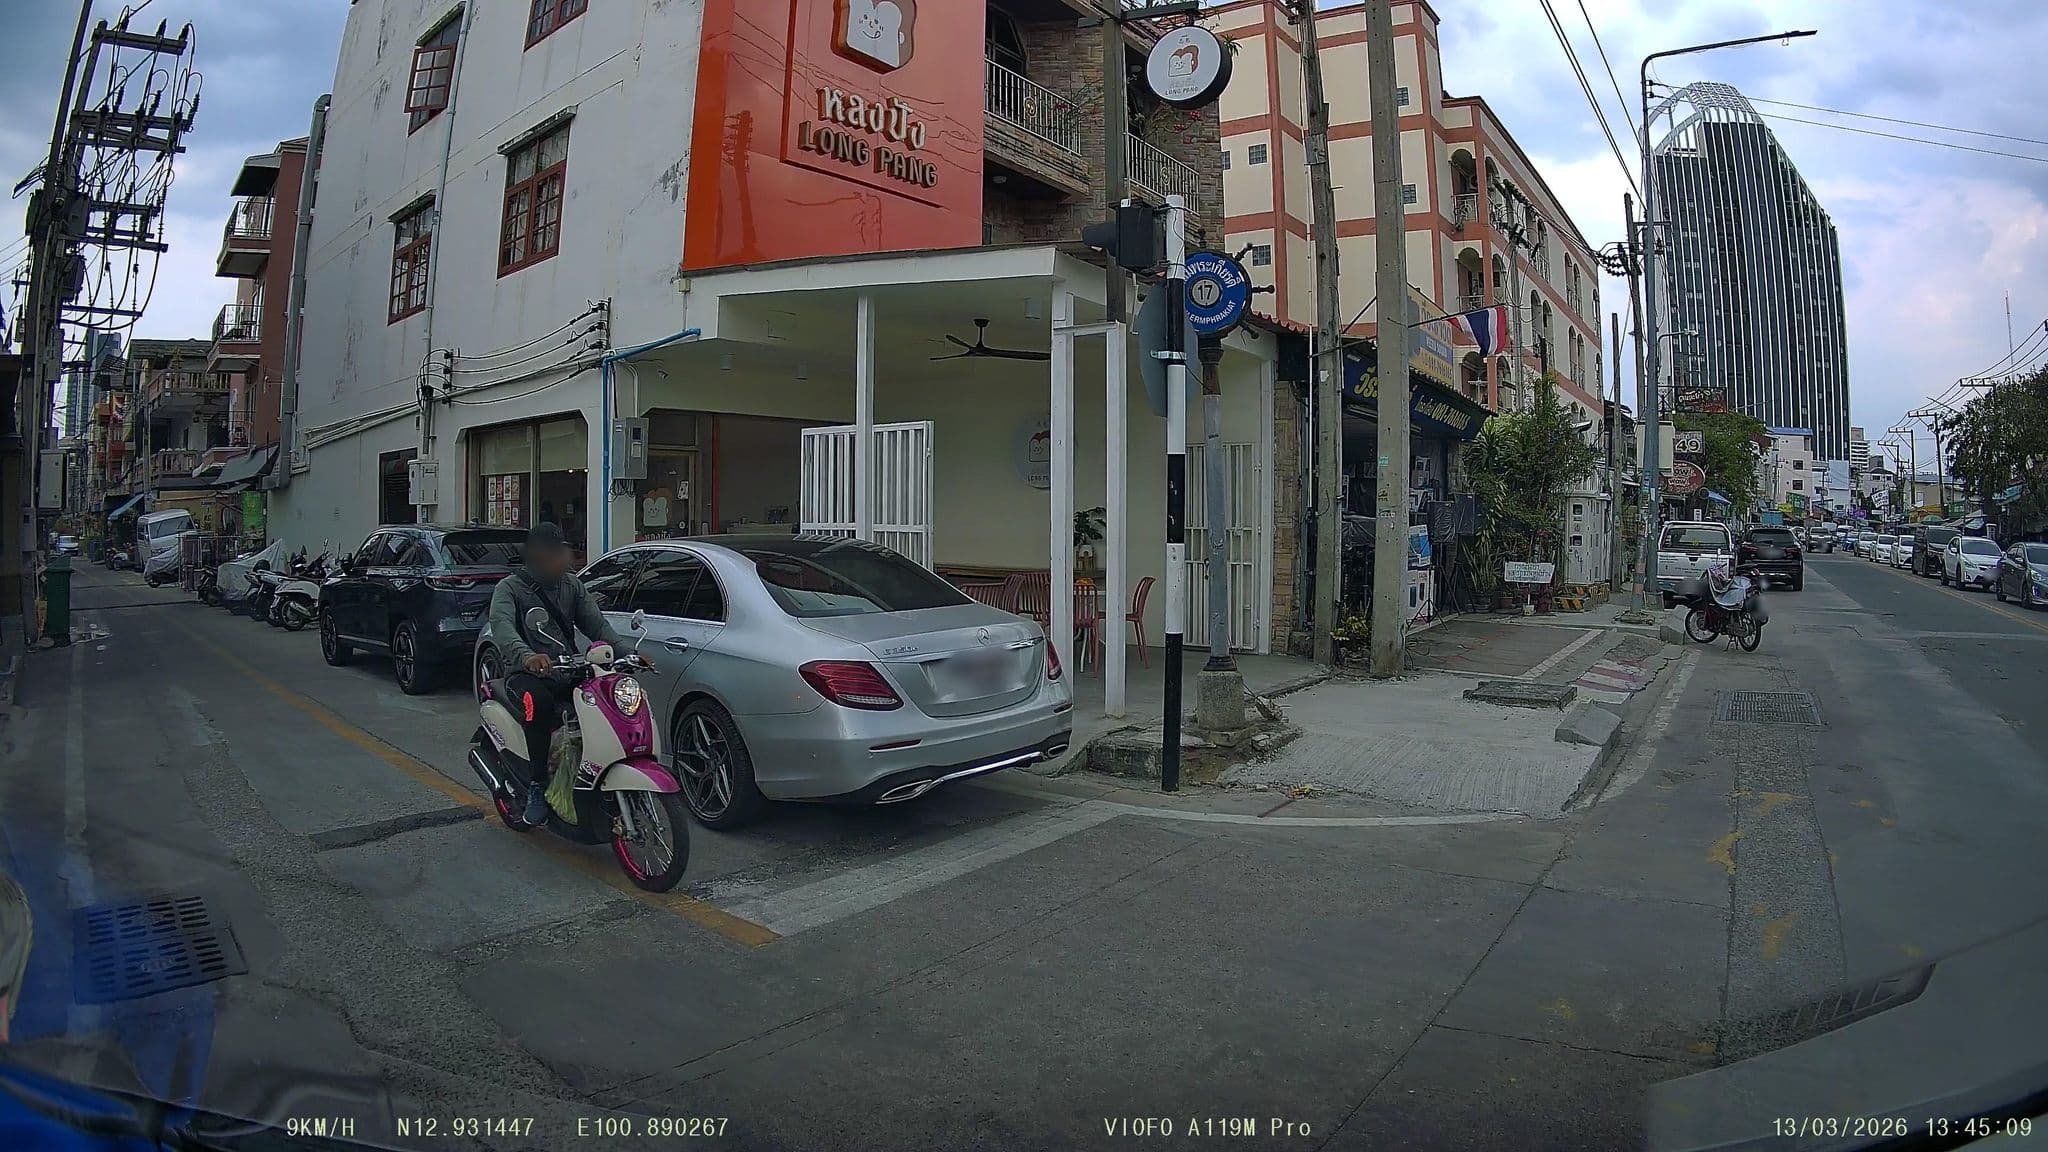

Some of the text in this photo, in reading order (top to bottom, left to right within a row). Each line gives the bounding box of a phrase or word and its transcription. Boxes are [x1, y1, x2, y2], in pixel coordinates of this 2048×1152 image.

[817, 85, 927, 150] หลงปัง
[798, 120, 938, 188] LONG PANG
[1197, 284, 1213, 300] 17
[1675, 438, 1701, 453] 49
